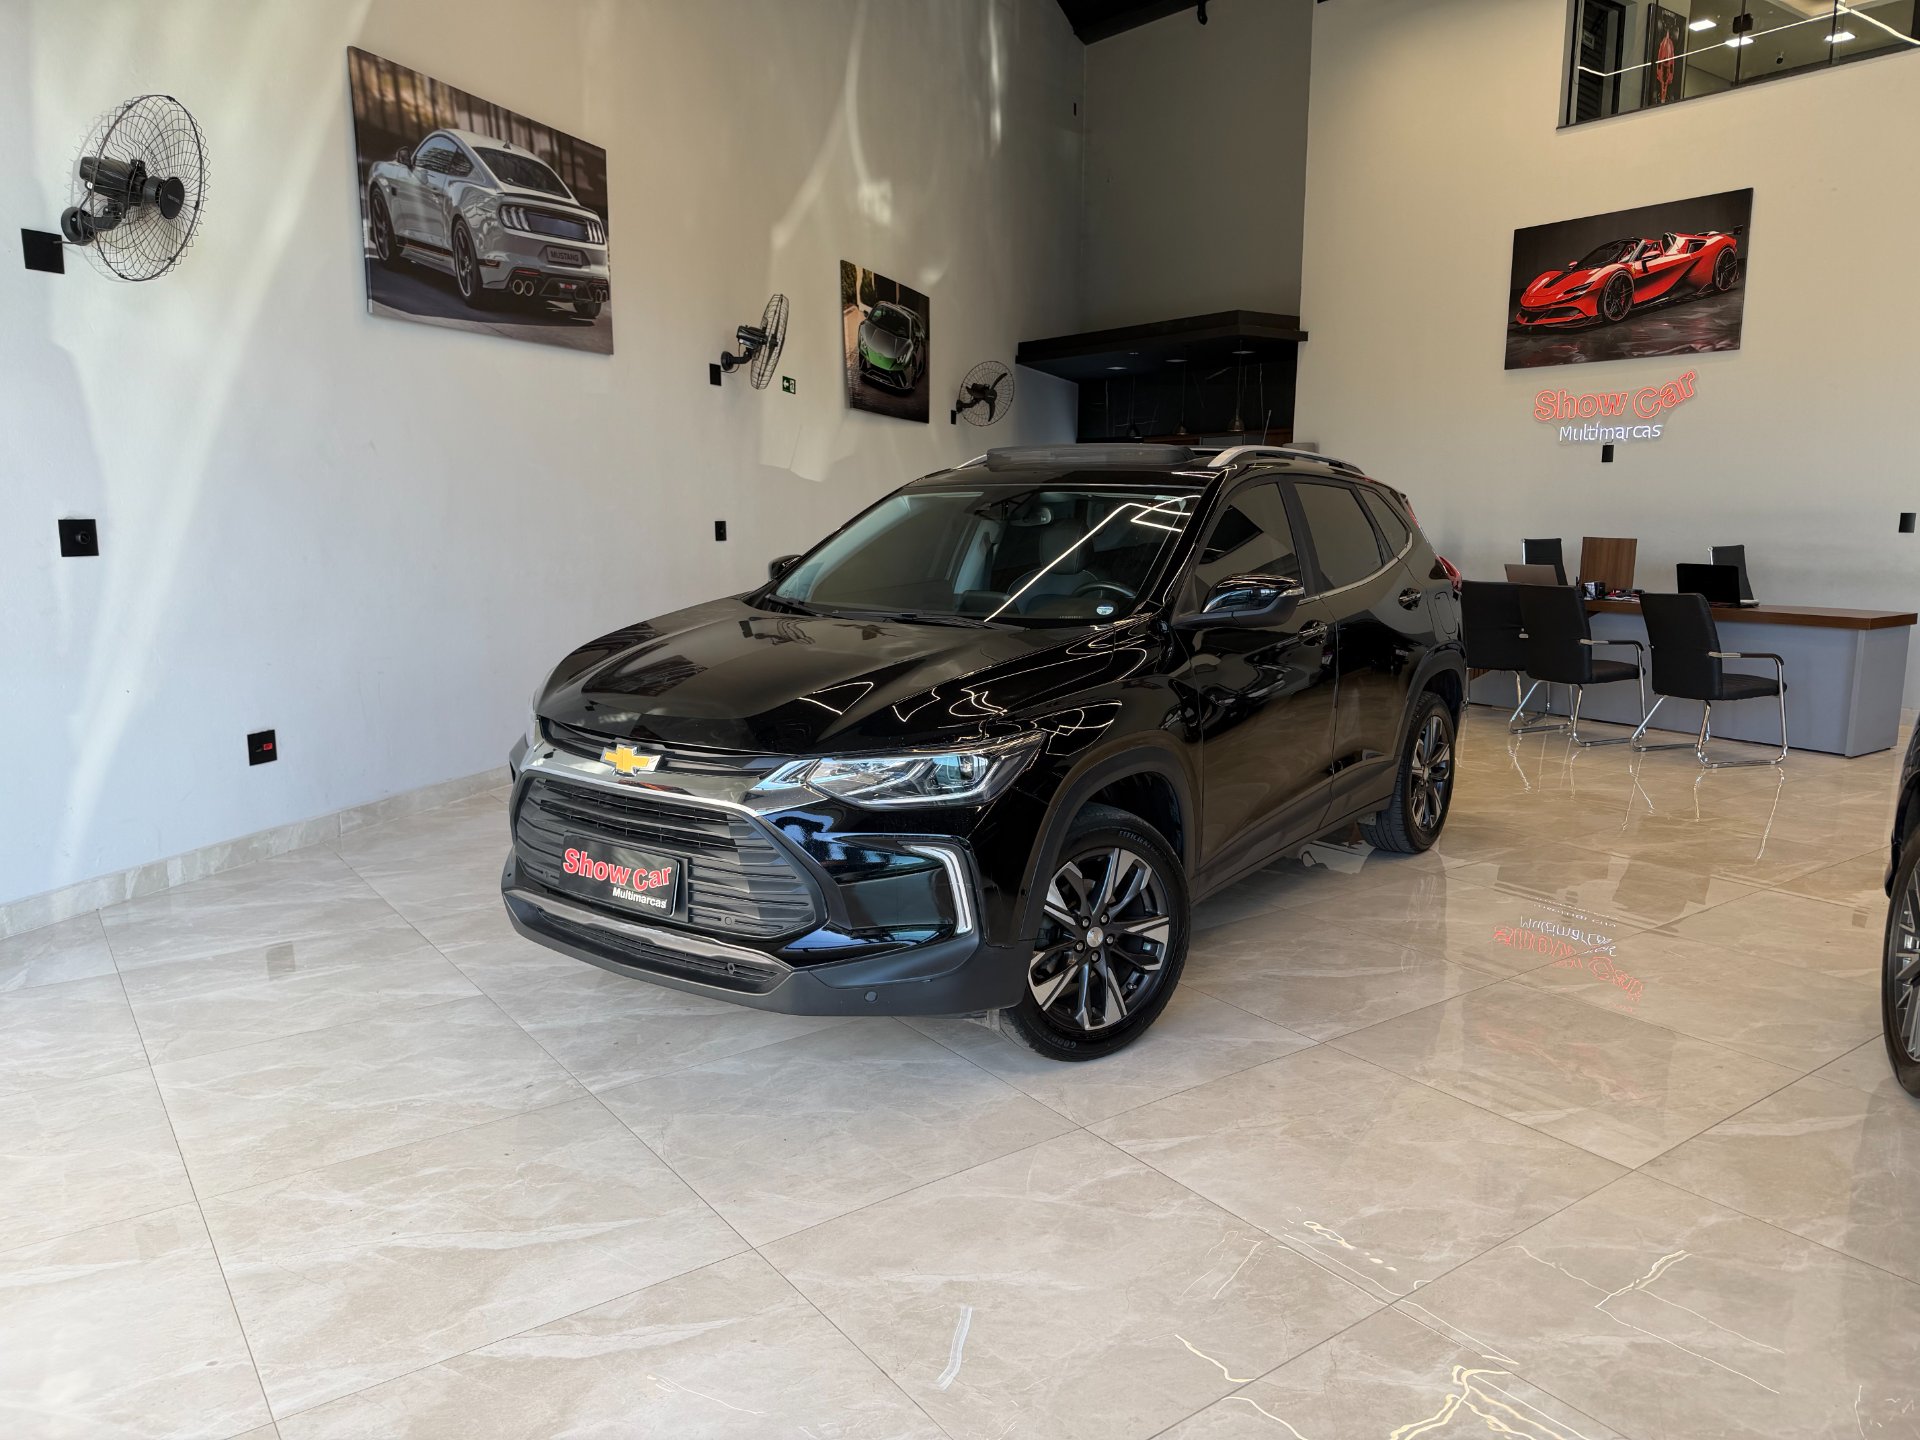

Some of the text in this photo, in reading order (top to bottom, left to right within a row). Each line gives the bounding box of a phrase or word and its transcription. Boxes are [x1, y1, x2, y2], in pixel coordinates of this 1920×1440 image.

[550, 250, 579, 262] MUSTANG
[1534, 371, 1696, 421] Show Car
[1559, 422, 1662, 442] Multimarcas
[563, 848, 672, 891] Show Car
[612, 886, 668, 908] Multimarcas
